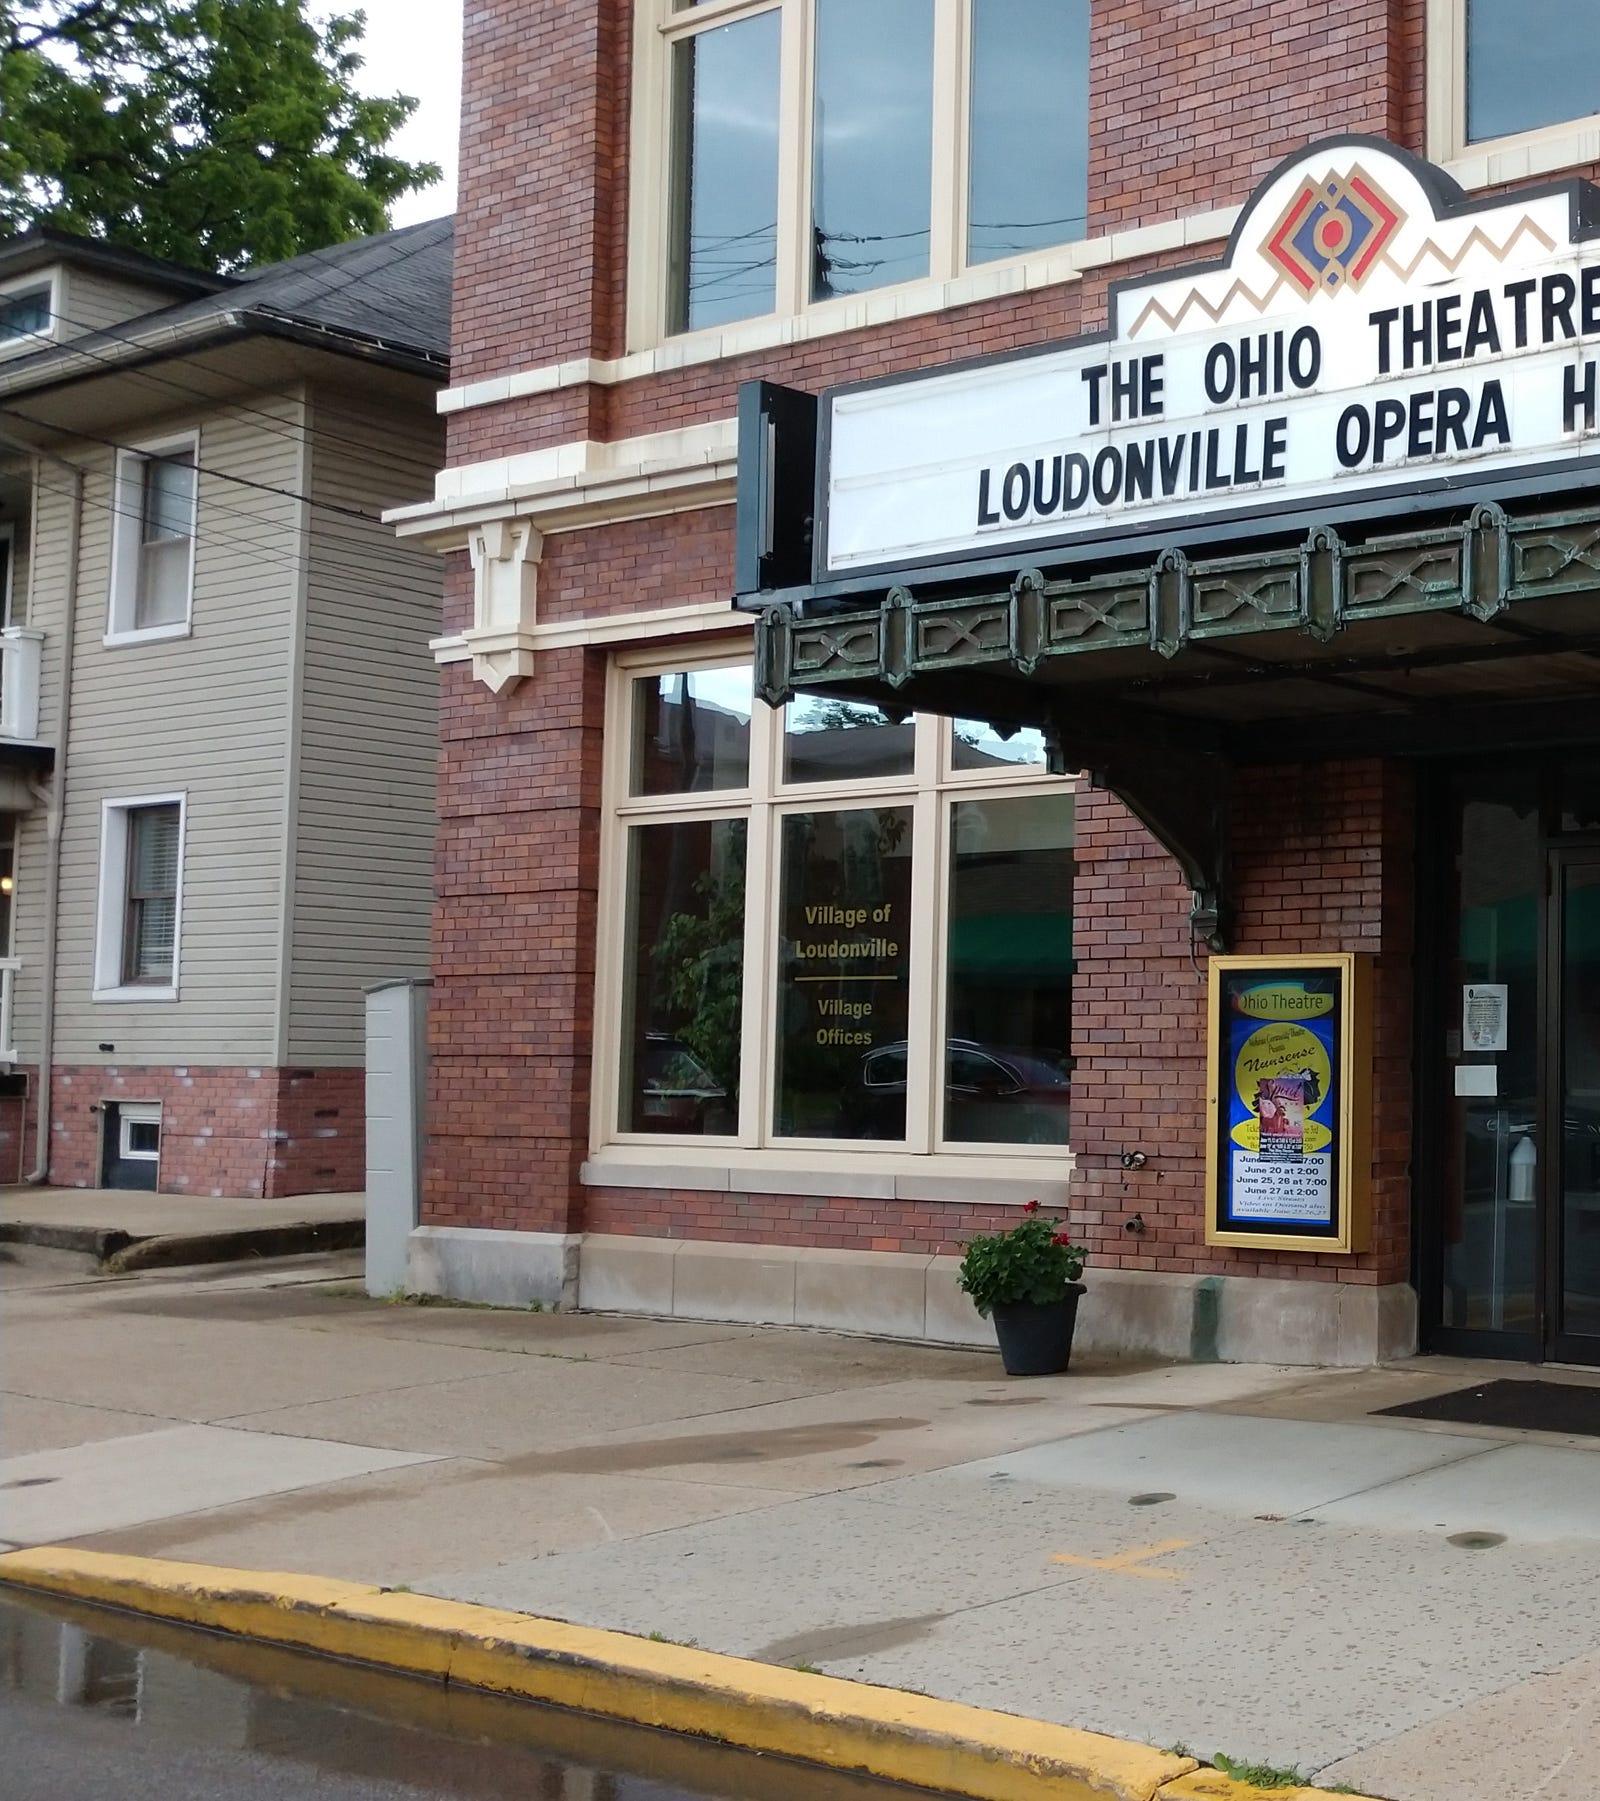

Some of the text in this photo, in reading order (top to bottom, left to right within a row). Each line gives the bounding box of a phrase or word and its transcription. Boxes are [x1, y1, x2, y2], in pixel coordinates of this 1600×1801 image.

[1081, 353, 1163, 426] THE
[1204, 325, 1321, 404] OHIO
[977, 417, 1288, 525] LOUDONVILLE
[1336, 379, 1511, 468] OPERA
[805, 903, 892, 928] Village of
[795, 938, 898, 958] Loudonville
[818, 999, 872, 1019] Village
[1271, 993, 1323, 1010] Theatre
[816, 1029, 872, 1045] Offices
[1243, 1047, 1316, 1072] Nunsense
[1244, 1166, 1267, 1174] June
[1303, 1157, 1324, 1165] 7:00
[1260, 1177, 1275, 1185] 25,
[1306, 1178, 1327, 1186] 7:00
[1297, 1188, 1318, 1196] 2:00
